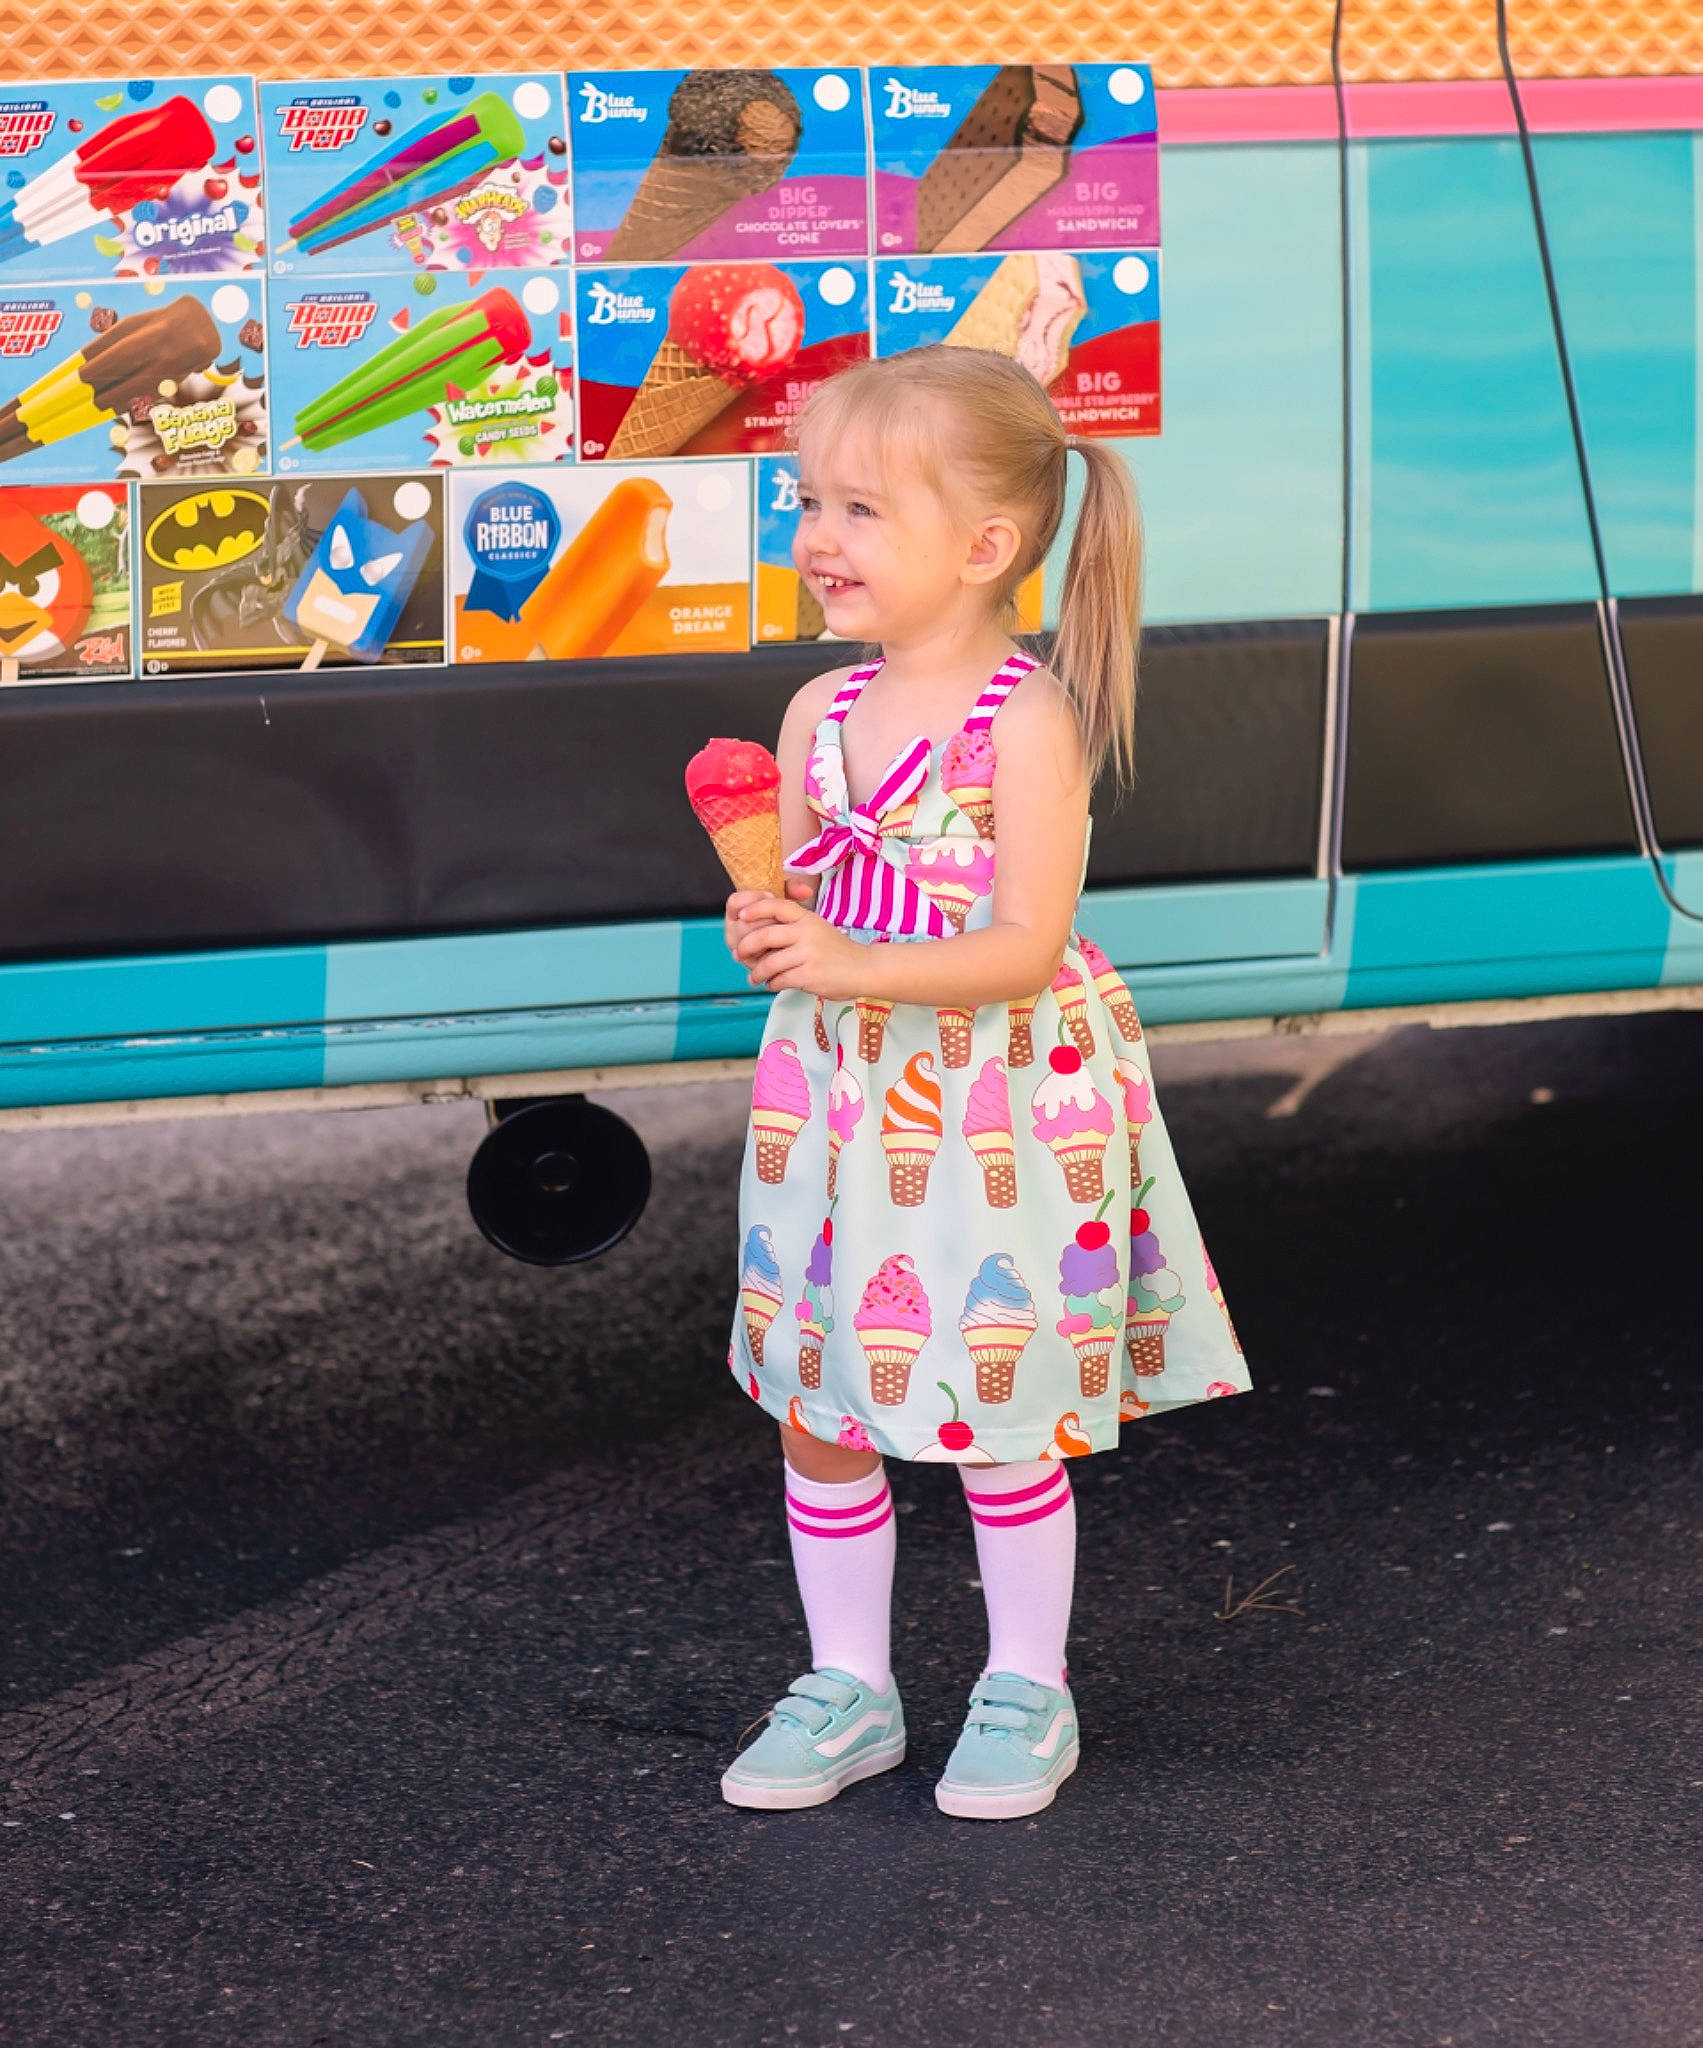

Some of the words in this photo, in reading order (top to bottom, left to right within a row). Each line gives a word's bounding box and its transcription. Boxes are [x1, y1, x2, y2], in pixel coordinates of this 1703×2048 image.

[579, 82, 634, 114] Blue
[884, 78, 938, 110] Blue
[885, 89, 951, 118] Bunny
[580, 93, 647, 123] Bunny
[0, 133, 45, 156] OP
[281, 128, 357, 150] POP
[779, 186, 818, 205] BIG
[1075, 182, 1120, 201] BIG
[768, 205, 828, 219] DIPPER
[135, 207, 238, 246] Original
[735, 221, 809, 233] CHOCOLATE
[1056, 218, 1138, 232] SANDWICH
[777, 232, 820, 245] CONE
[587, 282, 644, 314] Blue
[889, 271, 943, 303] Blue
[889, 282, 956, 313] Bunny
[588, 293, 656, 324] Bunny
[288, 325, 367, 348] POP
[1077, 372, 1121, 392] BIG
[156, 401, 233, 431] Banana
[449, 394, 552, 421] Watermelon
[1059, 407, 1139, 423] SANDWICH
[164, 420, 234, 453] Fudge
[490, 506, 533, 522] BLUE
[477, 520, 548, 552] RIBBON
[488, 551, 538, 561] CLASSICS
[669, 605, 733, 620] ORANGE
[147, 627, 179, 638] CHERRY
[673, 621, 727, 634] DREAM
[147, 638, 188, 648] FLAVORED
